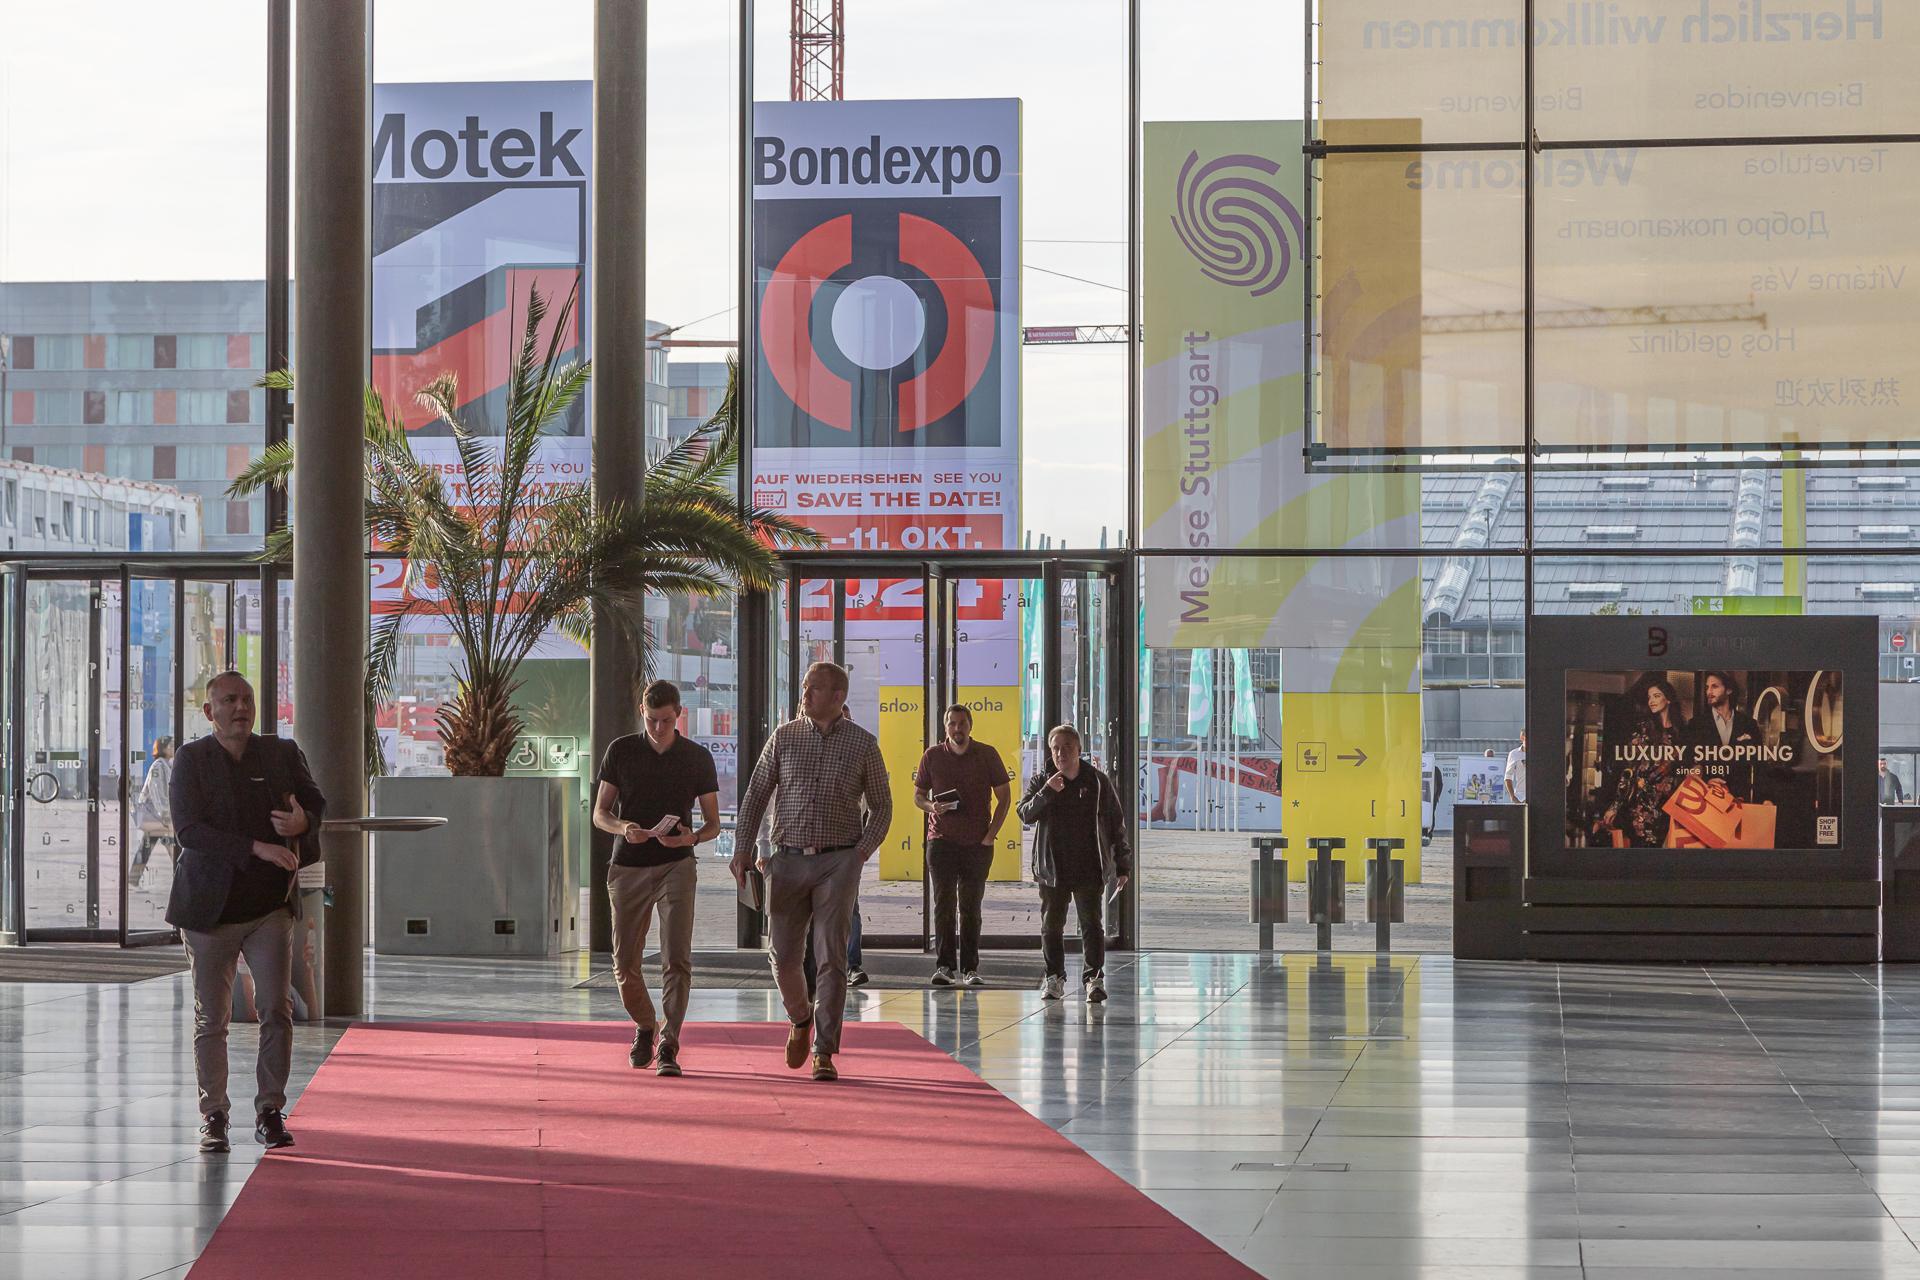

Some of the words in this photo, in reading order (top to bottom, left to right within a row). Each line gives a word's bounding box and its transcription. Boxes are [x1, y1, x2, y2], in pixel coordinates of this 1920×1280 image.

[753, 135, 1001, 195] Bondexpo
[1180, 330, 1219, 497] Stuttgart
[551, 463, 584, 474] YOU
[754, 474, 789, 484] AUF
[795, 473, 922, 484] WIEDERSEHEN
[934, 472, 963, 484] SEE
[969, 472, 1002, 483] YOU
[797, 491, 862, 508] SAVE
[870, 491, 921, 507] THE
[929, 491, 1001, 507] DATE!
[901, 526, 983, 549] OKT.
[1615, 745, 1685, 761] LUXURY
[1694, 745, 1793, 762] SHOPPING
[1676, 765, 1701, 775] since
[1705, 765, 1731, 775] 1881
